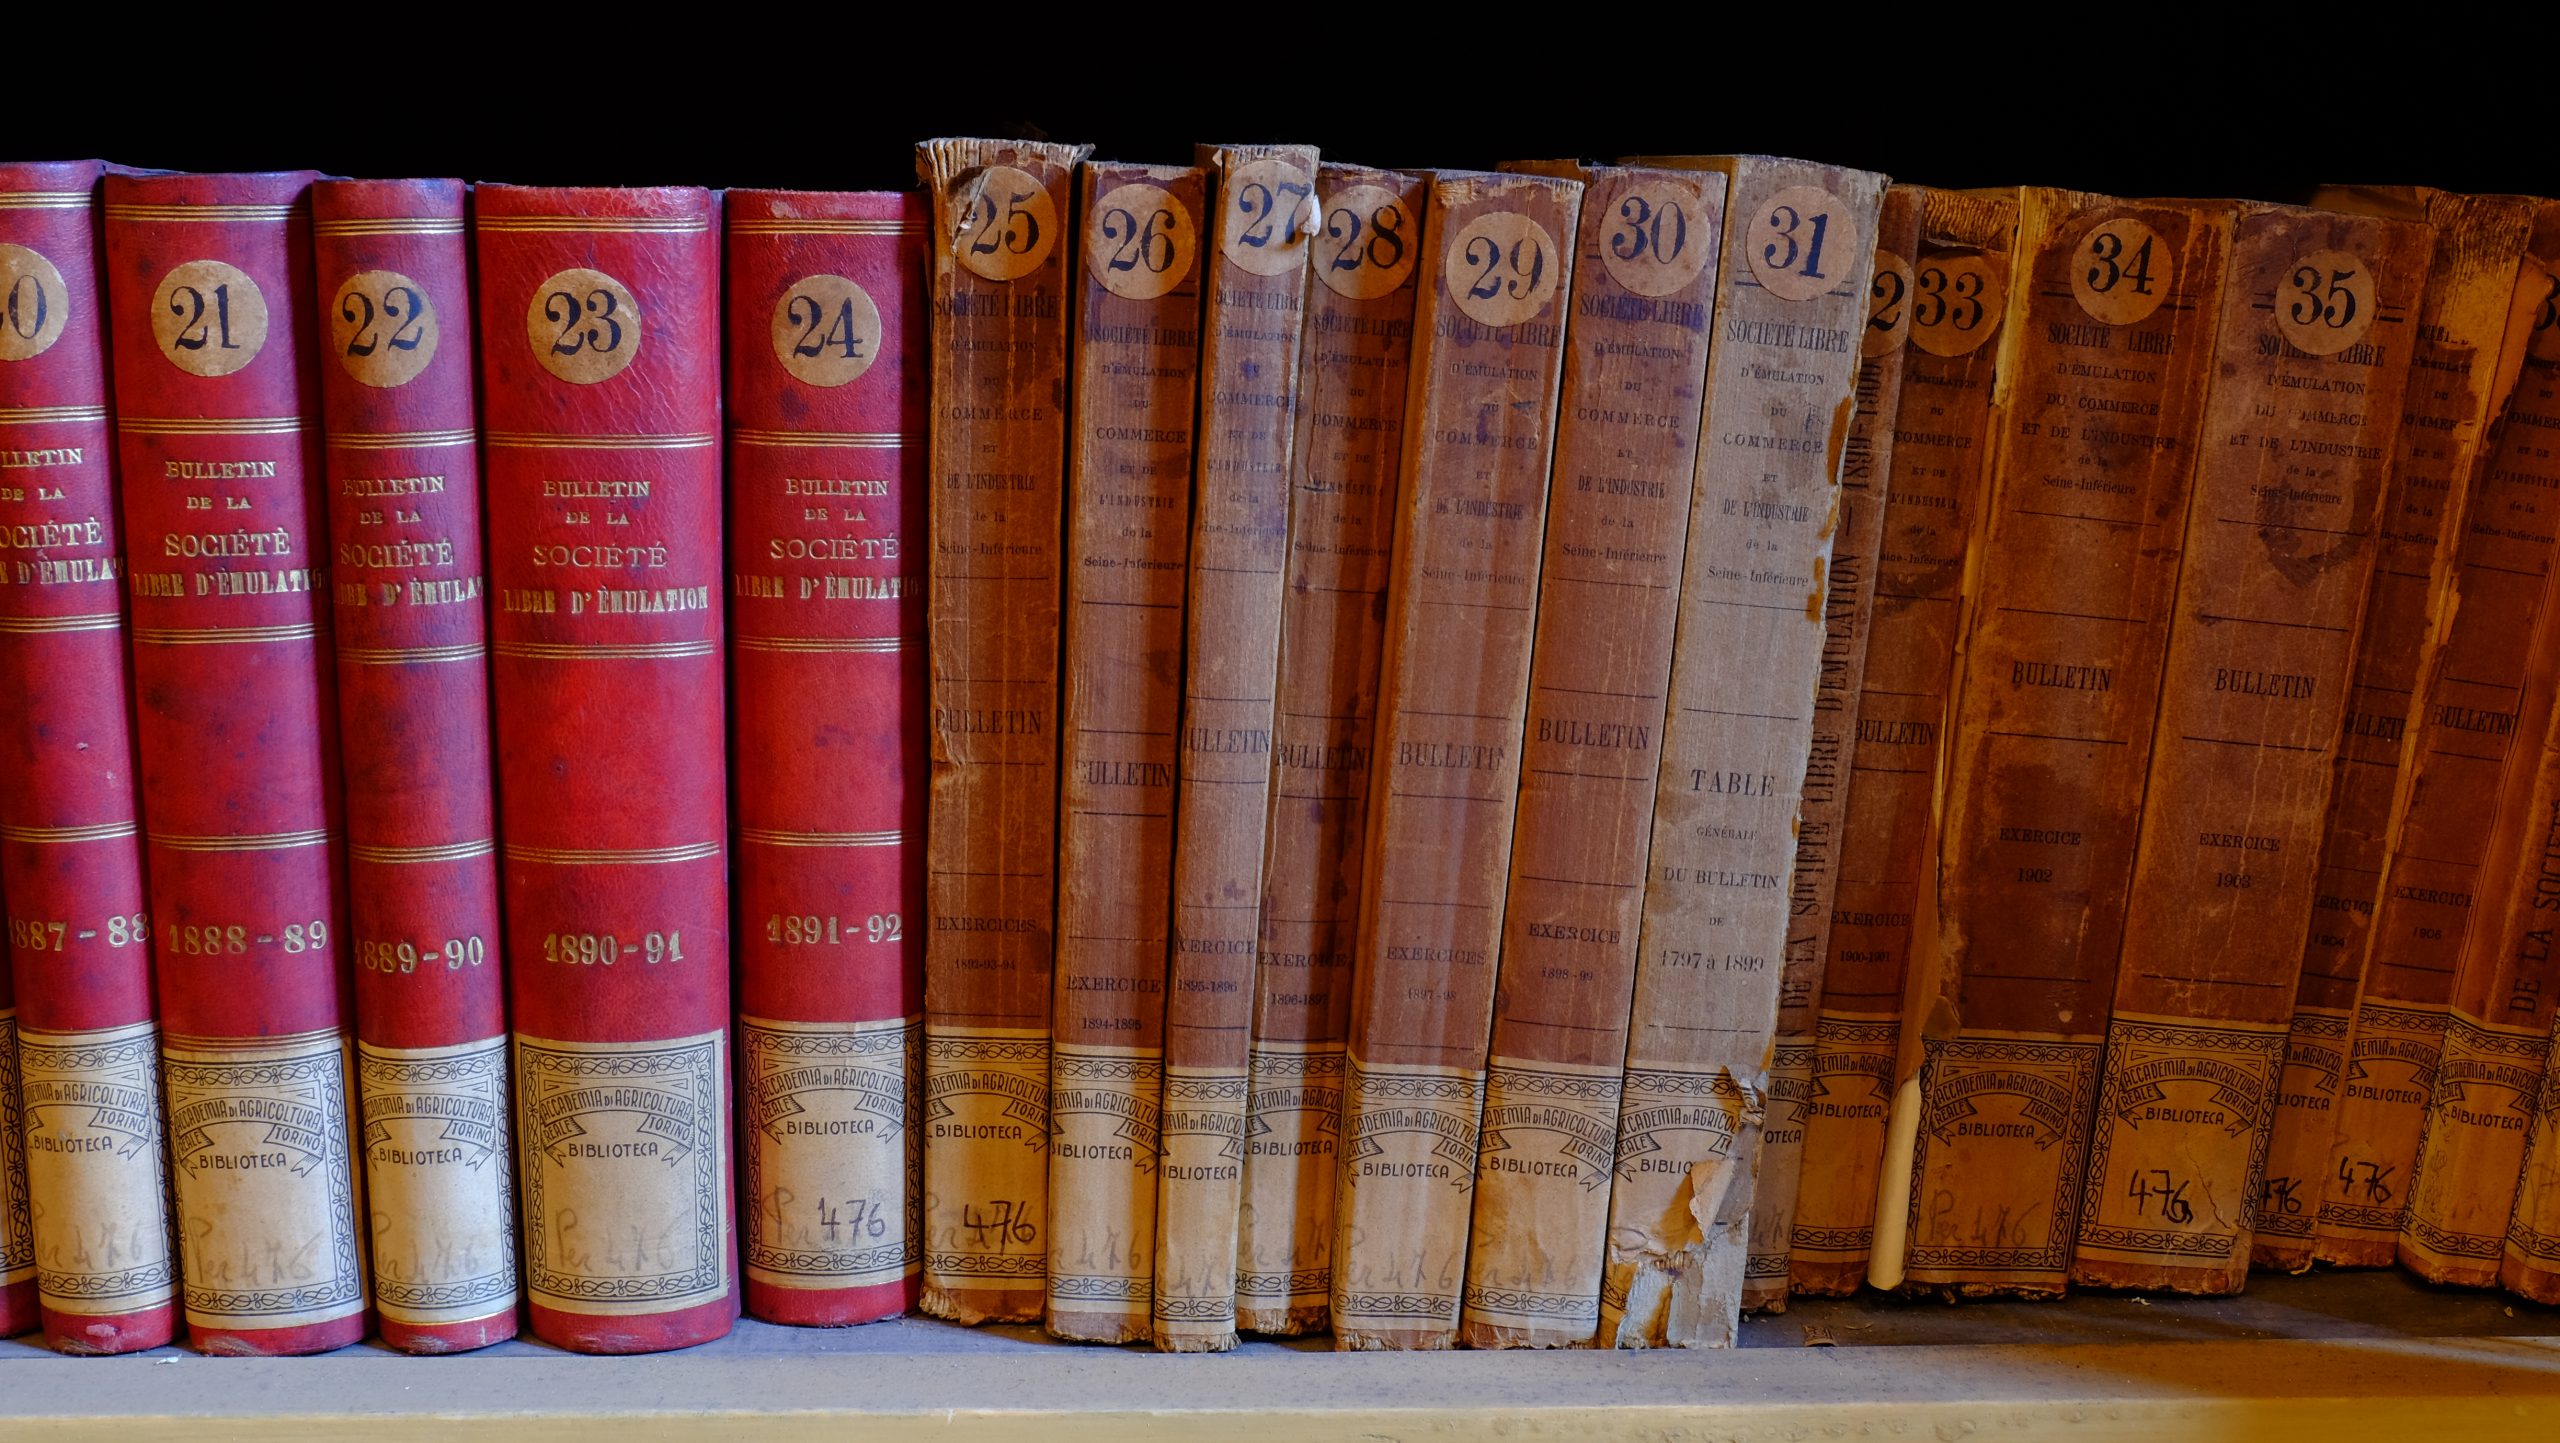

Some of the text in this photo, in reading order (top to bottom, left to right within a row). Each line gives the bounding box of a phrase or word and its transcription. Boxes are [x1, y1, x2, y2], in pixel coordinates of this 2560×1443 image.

[969, 191, 1040, 256] 25
[1238, 182, 1314, 247] 27
[1103, 208, 1176, 274] 26
[1327, 205, 1405, 272] 28
[1611, 196, 1686, 265] 30
[1764, 206, 1829, 279] 31
[1465, 236, 1543, 300] 29
[2087, 233, 2155, 296] 34
[1916, 268, 1984, 331] 33
[2291, 266, 2357, 329] 35
[170, 284, 240, 351] 21
[342, 286, 424, 357] 22
[544, 289, 622, 357] 23
[787, 295, 864, 359] 24
[1727, 316, 1849, 354] SOCIÉTÉ LIBRE
[2128, 330, 2176, 355] LIBRE
[1624, 381, 1642, 392] DU
[941, 407, 1043, 421] COMMERCE
[1771, 406, 1788, 417] DU
[2046, 392, 2159, 415] DU COMMERCE
[2256, 405, 2276, 418] DU
[1313, 414, 1397, 432] COMMERCE
[1578, 408, 1680, 428] COMMERCE
[1096, 427, 1186, 444] COMMERCE
[1436, 431, 1537, 450] COMMERCE
[2020, 422, 2070, 438] ET DE
[1723, 433, 1824, 454] COMMERCE
[2229, 433, 2383, 461] ET DE L'INDUSTRIE
[165, 461, 277, 479] BULLETIN
[1763, 474, 1779, 482] ET
[39, 488, 65, 500] LA
[343, 476, 444, 496] BULLETIN
[543, 480, 651, 498] BULLETIN
[785, 479, 889, 498] BULLETIN
[1578, 475, 1665, 499] DE L'INDUSTRIE
[187, 497, 252, 509] DE LA
[1723, 499, 1809, 523] DE L'INDUSTRIE
[360, 510, 421, 525] DE LA
[565, 511, 630, 525] DE LA
[804, 508, 866, 522] DE LA
[534, 540, 669, 568] SOCIÉTÉ
[770, 531, 901, 560] SOCIÉTÉ
[1745, 540, 1778, 551] de la
[135, 573, 185, 597] LIBRE
[735, 574, 785, 598] LIBRE
[504, 590, 556, 613] LIBRE
[2012, 661, 2113, 692] BULLETIN
[2215, 668, 2316, 699] BULLETIN
[936, 708, 1042, 736] BULLETIN
[2432, 703, 2515, 736] BULLETIN
[1539, 718, 1650, 750] BULLETIN
[1400, 742, 1505, 771] BULLETIN
[1690, 769, 1776, 798] TABLE
[1696, 823, 1758, 842] GÉNÉRALE
[2000, 828, 2082, 846] EXERCICE
[2199, 833, 2281, 852] EXERCICE
[1663, 867, 1781, 889] DU BULLETIN
[2017, 867, 2054, 883] 1902
[2215, 872, 2252, 889] 1903
[2395, 887, 2473, 907] EXERCICE
[936, 917, 1038, 932] EXERCICES
[1708, 916, 1725, 927] DE
[1529, 923, 1620, 944] EXERCICE
[1260, 951, 1347, 967] EXERCICE
[1386, 946, 1486, 966] EXERCICES
[1661, 950, 1703, 970] 1797
[1724, 954, 1765, 974] 1899
[1067, 976, 1161, 994] EXERCICE
[2509, 978, 2541, 1014] DE
[1081, 1016, 1142, 1032] 1894-1895
[760, 1069, 907, 1100] ACCADEMIA AGRICOLTURA
[1935, 1073, 2070, 1108] ACCADEMIA AGRICOLTURA
[2123, 1060, 2262, 1101] ACCADEMIA AGRICOLTURA
[63, 1084, 148, 1114] AGRICOLTURA
[2120, 1085, 2254, 1117] REALE TORINO
[2348, 1085, 2422, 1105] BIBLIOTECA
[175, 1099, 322, 1136] ACCADEMIA AGRICOLTURA
[416, 1096, 493, 1124] AGRICOLTURA
[541, 1088, 694, 1126] ACCADEMIA AGRICOLTURA
[762, 1093, 904, 1123] REALE TORINO
[1808, 1101, 1881, 1118] BIBLIOTECA
[1934, 1101, 2065, 1129] REALE TORINO
[2145, 1107, 2225, 1126] BIBLIOTECA
[2450, 1106, 2525, 1131] BIBLIOTECA
[99, 1110, 148, 1133] TORINO
[543, 1116, 691, 1142] REALE TORINO
[787, 1119, 874, 1136] BIBLIOTECA
[936, 1123, 1022, 1140] BIBLIOTECA
[1543, 1107, 1615, 1148] AGRICOLTURA
[1957, 1122, 2035, 1138] BIBLIOTECA
[34, 1136, 113, 1153] BIBLIOTECA
[274, 1124, 322, 1152] TORINO
[450, 1123, 493, 1145] TORINO
[379, 1147, 462, 1165] BIBLIOTECA
[568, 1142, 659, 1158] BIBLIOTECA
[1252, 1141, 1333, 1156] BIBLIOTECA
[1571, 1139, 1611, 1169] TORINO
[200, 1152, 287, 1170] BIBLIOTECA
[1364, 1162, 1449, 1179] BIBLIOTECA
[1491, 1157, 1578, 1178] BIBLIOTECA
[2338, 1157, 2396, 1204] 476
[817, 1197, 886, 1248] 476
[963, 1200, 1036, 1255] 476
